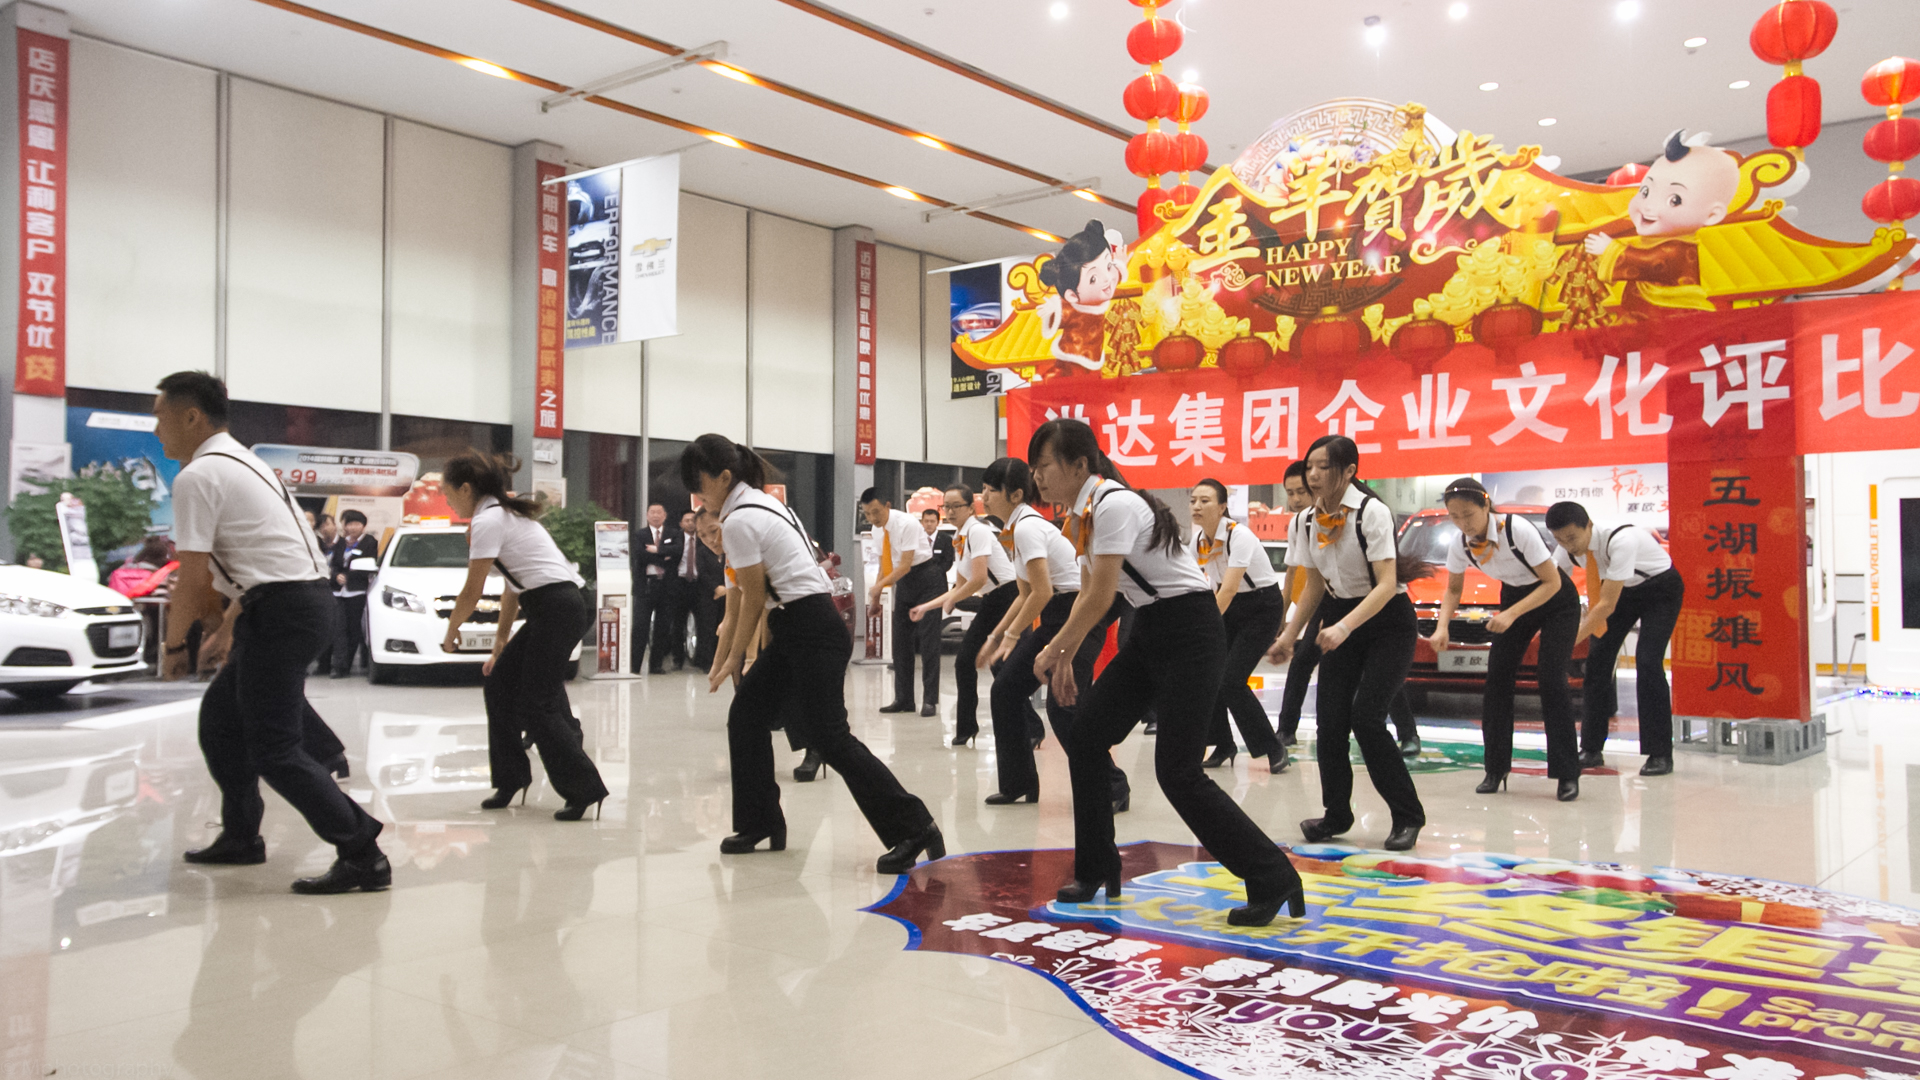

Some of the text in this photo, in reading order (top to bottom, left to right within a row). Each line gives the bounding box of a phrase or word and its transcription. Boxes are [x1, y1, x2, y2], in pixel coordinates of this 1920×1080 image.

[601, 186, 619, 345] ERFORMANCE
[1265, 254, 1402, 288] NEW YEAR
[1266, 237, 1352, 266] HAPPY
[1554, 487, 1604, 498] 因为有你
[1869, 522, 1880, 605] CHEVROLET
[1702, 475, 1765, 696] 五湖振雄风
[1219, 999, 1404, 1042] you
